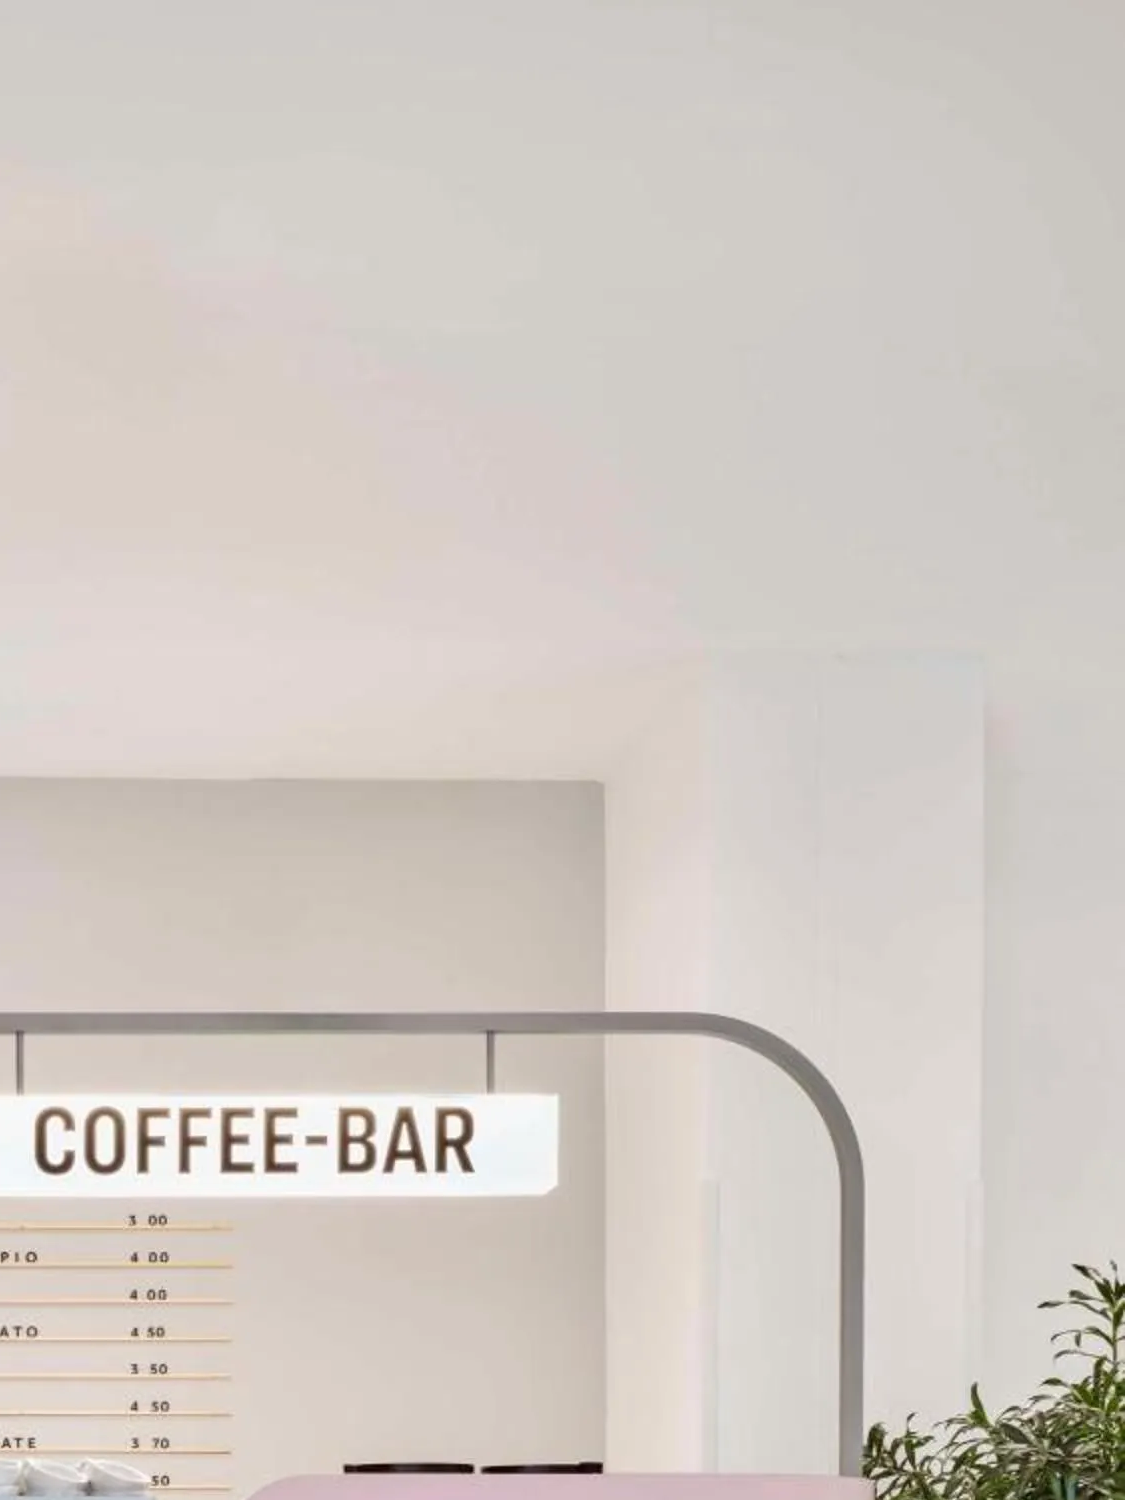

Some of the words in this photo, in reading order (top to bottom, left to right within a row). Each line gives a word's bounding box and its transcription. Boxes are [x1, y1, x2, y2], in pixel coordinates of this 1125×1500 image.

[34, 1106, 476, 1176] COFFEE-BAR
[128, 1214, 137, 1226] 3
[148, 1214, 168, 1226] 00
[130, 1251, 139, 1263] 4
[148, 1251, 170, 1263] 00
[129, 1288, 138, 1301] 4
[146, 1288, 167, 1301] 00
[130, 1326, 139, 1338] 4
[130, 1363, 139, 1375] 3
[130, 1400, 139, 1412] 4
[131, 1437, 140, 1449] 3
[152, 1437, 170, 1449] 70
